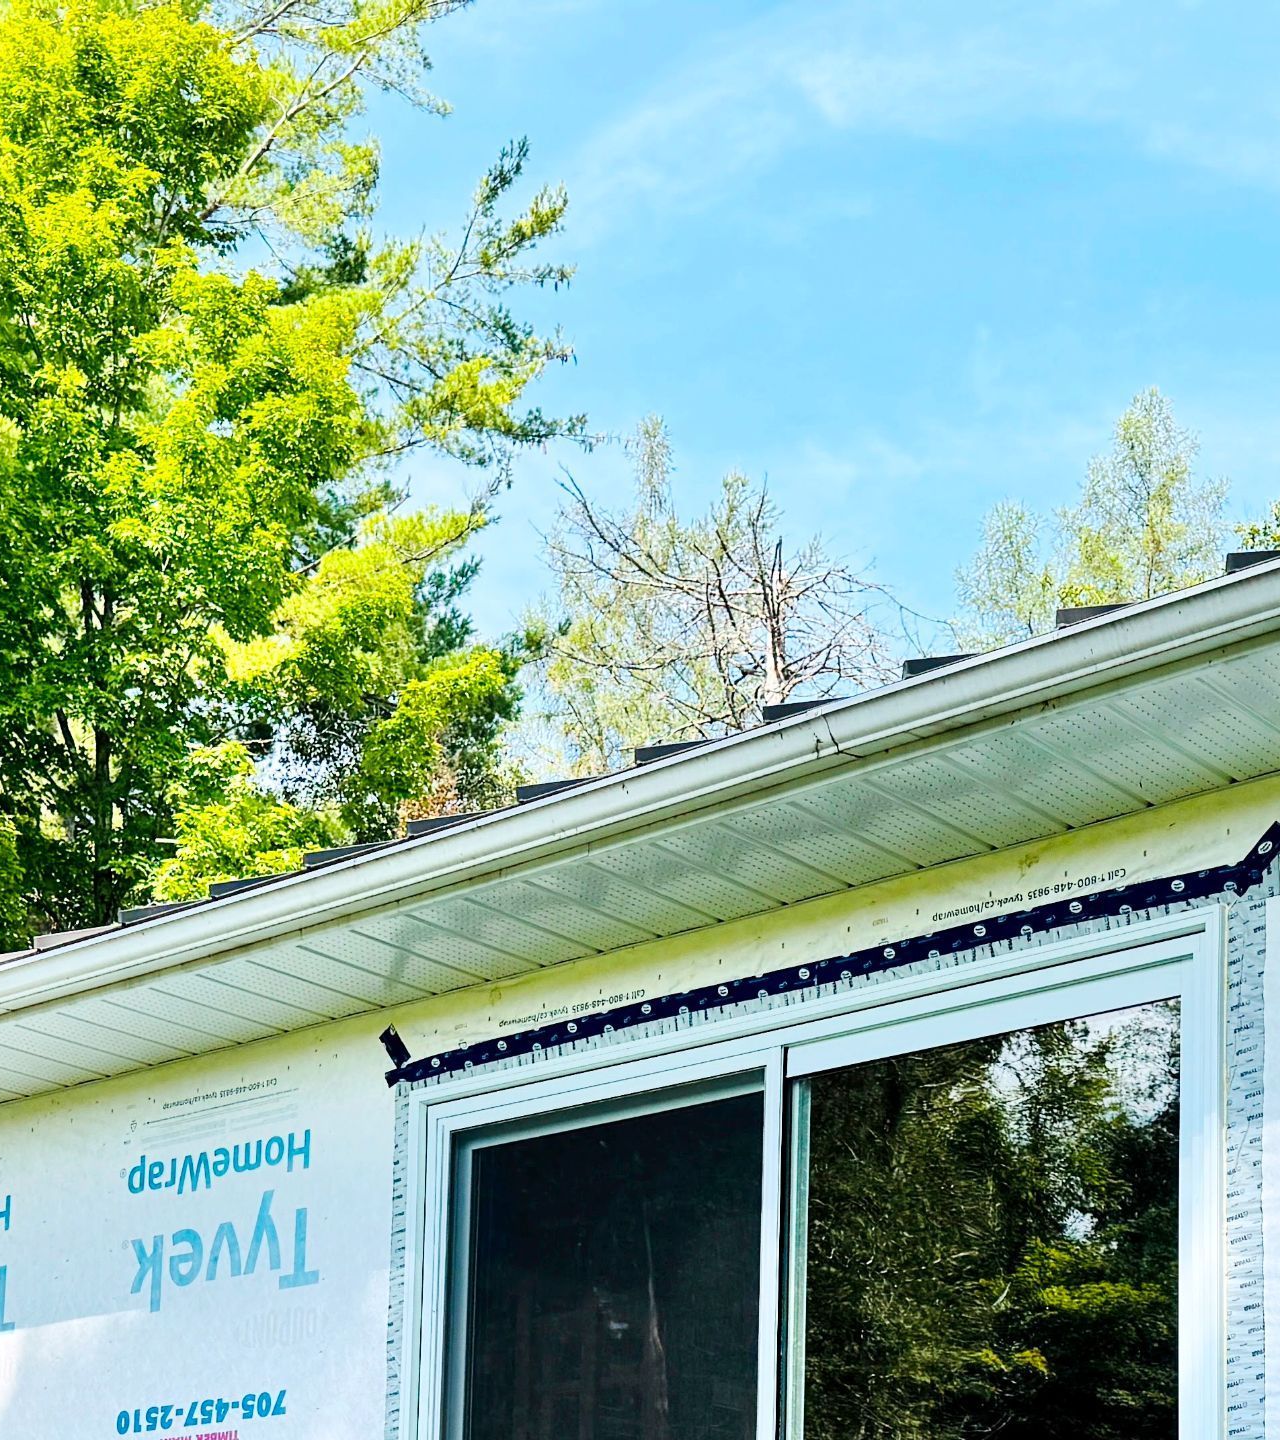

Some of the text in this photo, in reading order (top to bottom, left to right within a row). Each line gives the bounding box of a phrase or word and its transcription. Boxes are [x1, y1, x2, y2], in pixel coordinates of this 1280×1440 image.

[1107, 868, 1127, 881] Call
[127, 1129, 311, 1195] HomeWrap
[130, 1189, 320, 1313] Tyvek
[116, 1390, 287, 1435] 705-457-2510
